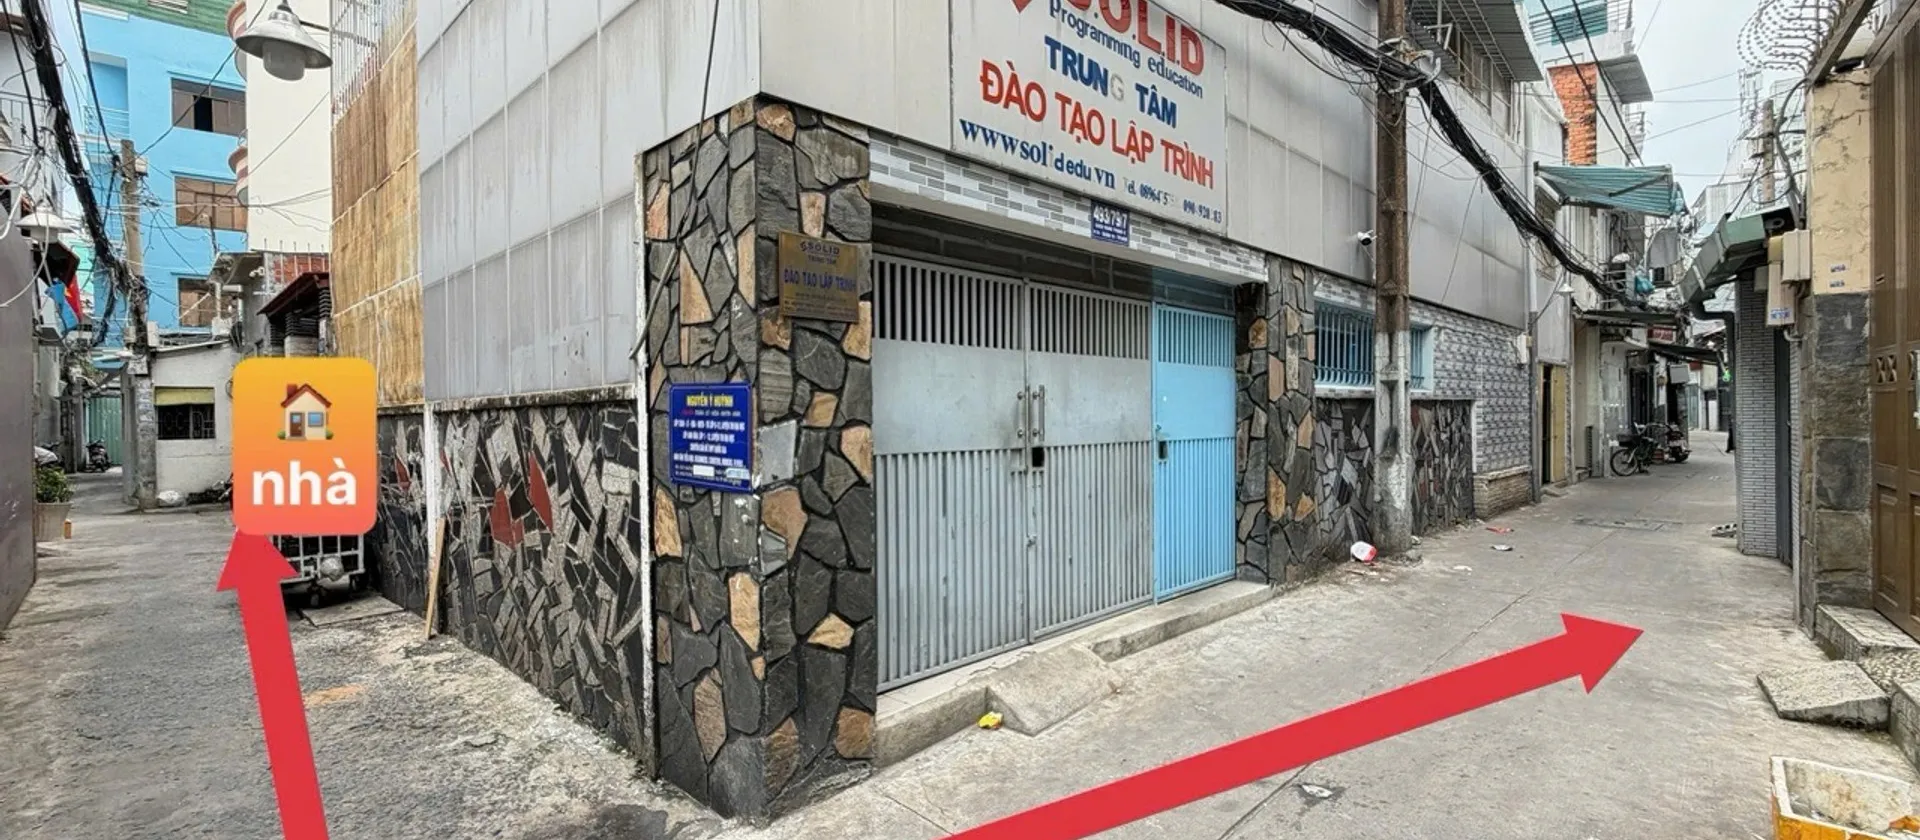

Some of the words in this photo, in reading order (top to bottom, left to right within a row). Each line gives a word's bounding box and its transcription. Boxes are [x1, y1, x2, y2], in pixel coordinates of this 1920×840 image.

[1044, 35, 1125, 101] TRUNG
[1135, 82, 1177, 129] TÂM
[1049, 0, 1141, 69] Programming
[1147, 55, 1203, 99] education
[1066, 0, 1205, 76] .O.L.I.D
[979, 59, 1047, 122] ĐÀO
[1054, 91, 1105, 146] TẠO
[1111, 118, 1155, 164] LẬP
[1160, 138, 1214, 190] TRÌNH
